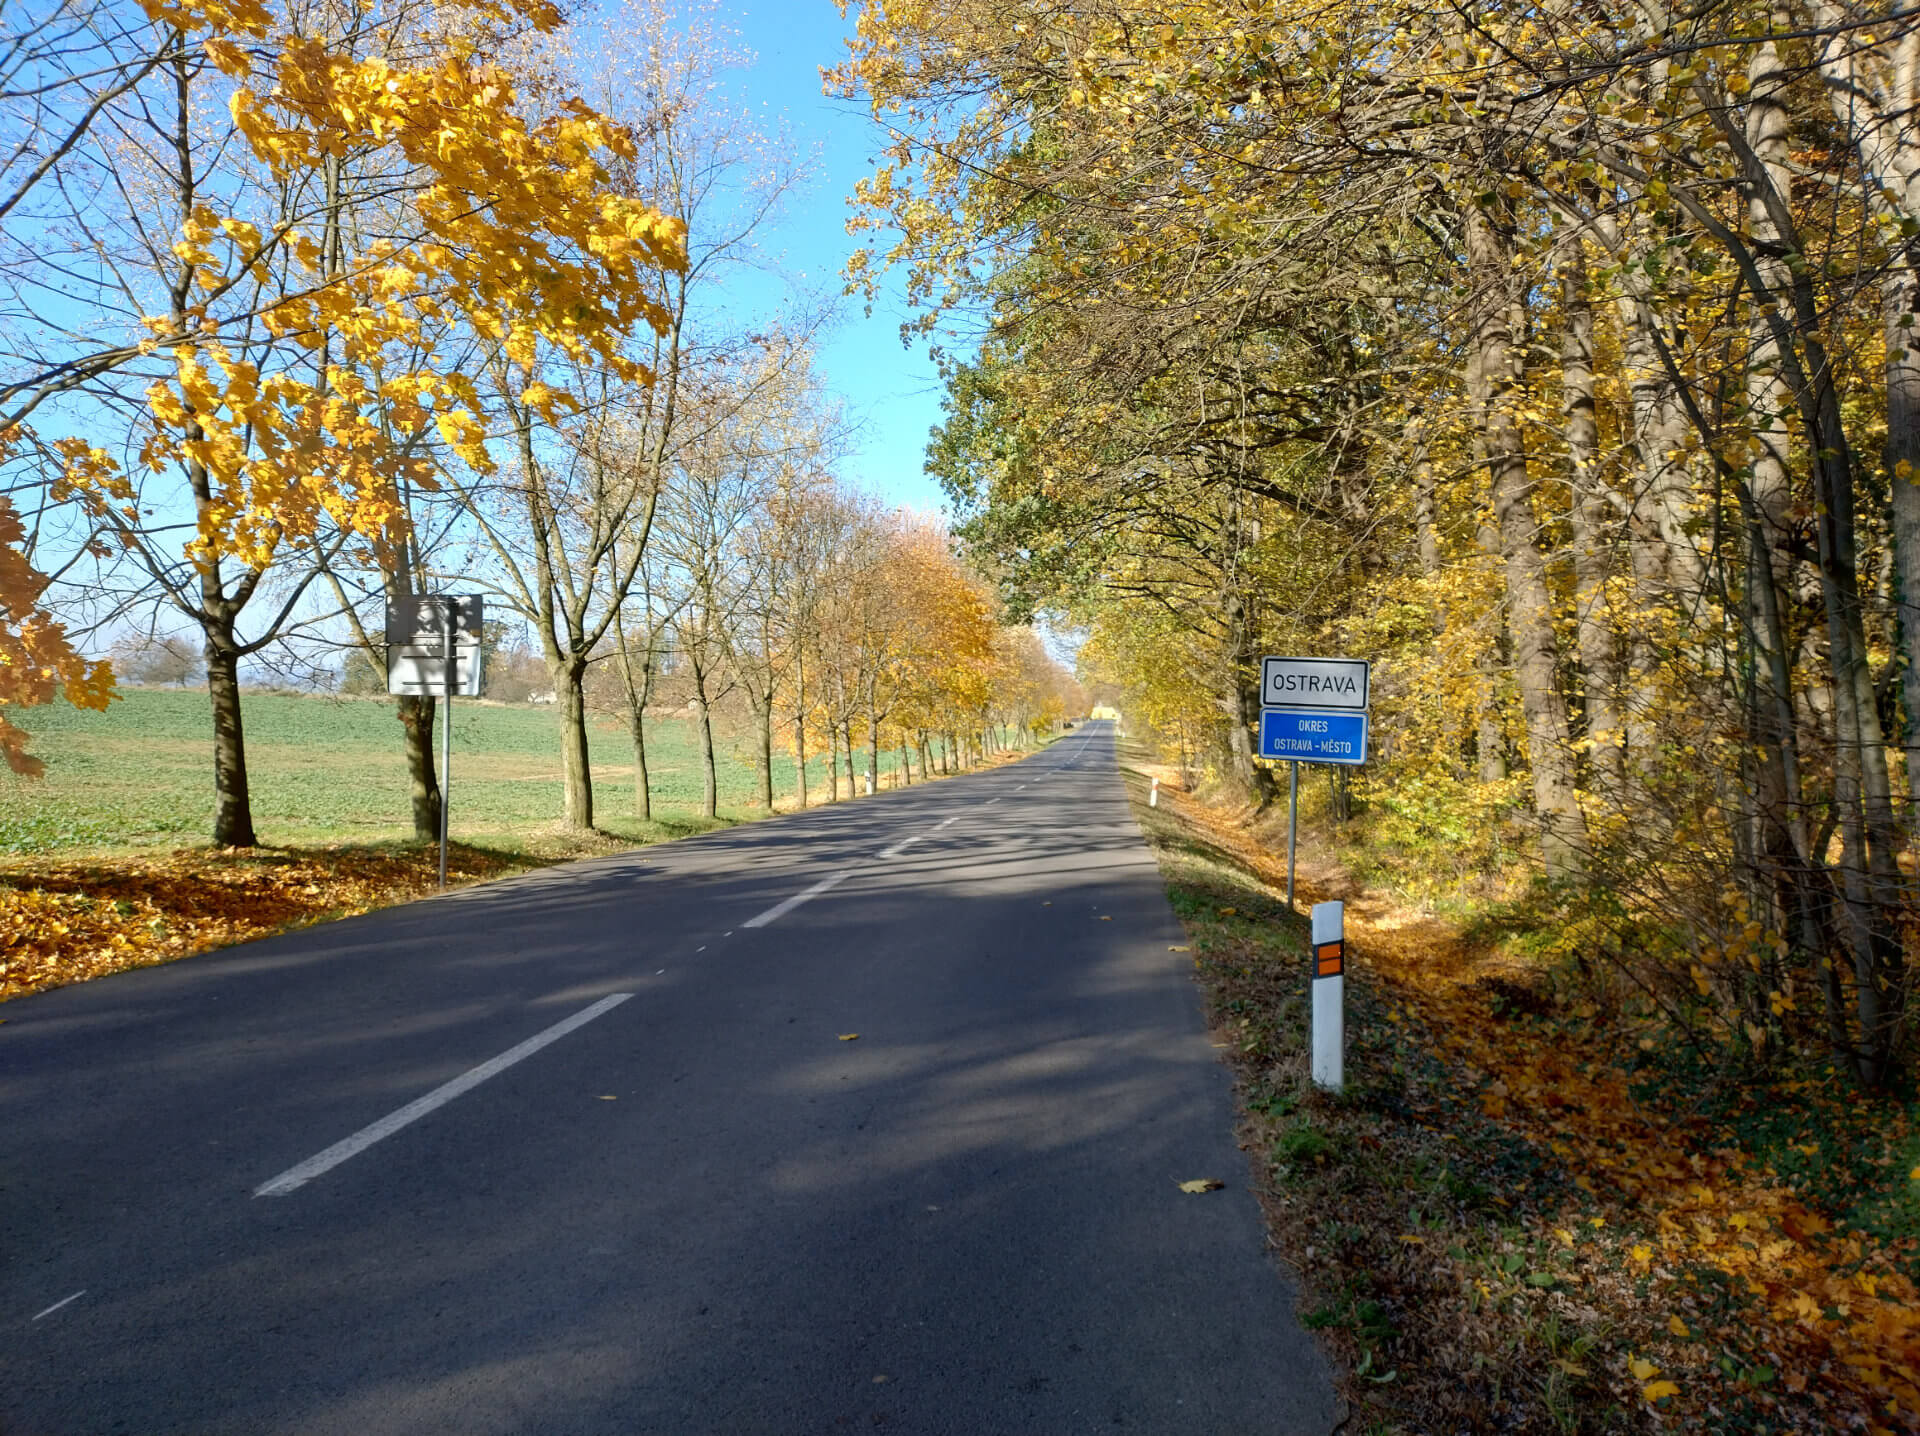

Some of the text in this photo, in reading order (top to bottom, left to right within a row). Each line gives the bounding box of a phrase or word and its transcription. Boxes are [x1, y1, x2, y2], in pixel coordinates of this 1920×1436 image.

[1273, 674, 1356, 693] OSTRAVA
[1298, 719, 1328, 733] OKRES
[1274, 738, 1312, 752] OSTRAVA
[1321, 739, 1351, 754] MĚSTO
